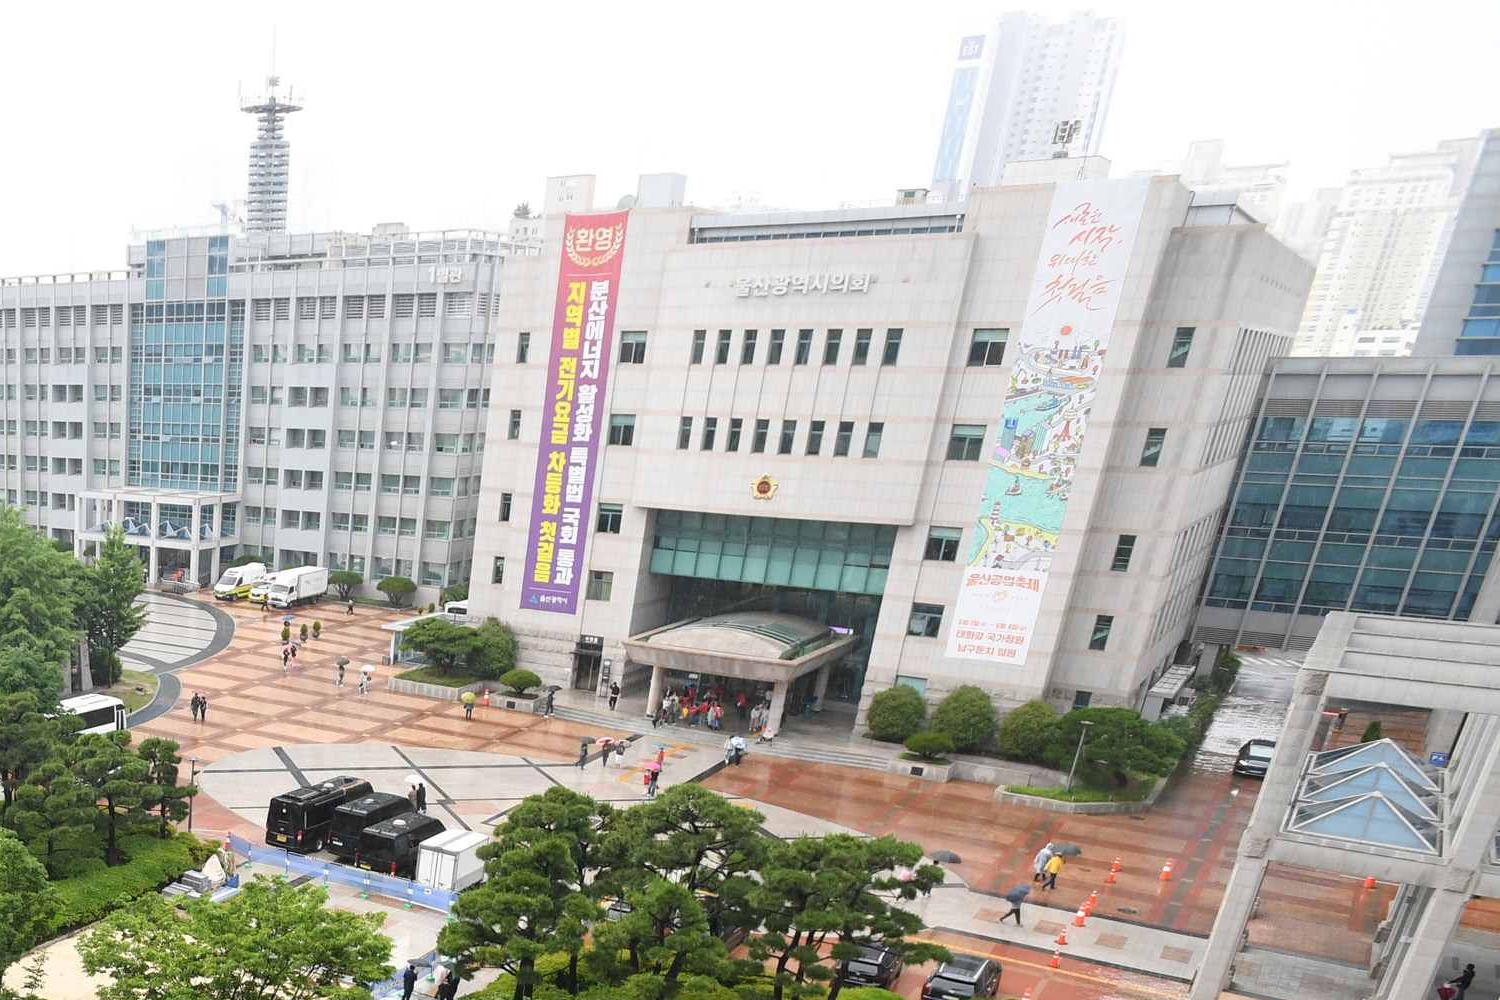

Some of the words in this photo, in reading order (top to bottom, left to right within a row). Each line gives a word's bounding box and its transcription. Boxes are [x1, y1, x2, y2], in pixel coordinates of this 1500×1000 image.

[962, 44, 980, 57] EST
[1052, 203, 1103, 229] 새로운
[575, 226, 614, 252] 환영
[1048, 250, 1099, 278] 위대한
[734, 272, 871, 298] 울산광역시의회
[1032, 274, 1117, 316] 첫걸음
[562, 281, 587, 350] 지역별
[580, 279, 610, 380] 분산에너지
[550, 356, 578, 445] 전기요금
[571, 383, 598, 442] 활성화
[541, 451, 567, 515] 차등화
[565, 447, 589, 503] 특별법
[559, 507, 581, 545] 국회
[533, 520, 558, 583] 첫걸음
[553, 548, 575, 586] 통과
[966, 573, 1040, 592] 울산공업축제
[956, 629, 984, 640] 태화강
[987, 632, 1025, 645] 국가정원
[958, 644, 995, 655] 남구둔치
[998, 648, 1017, 659] 일원
